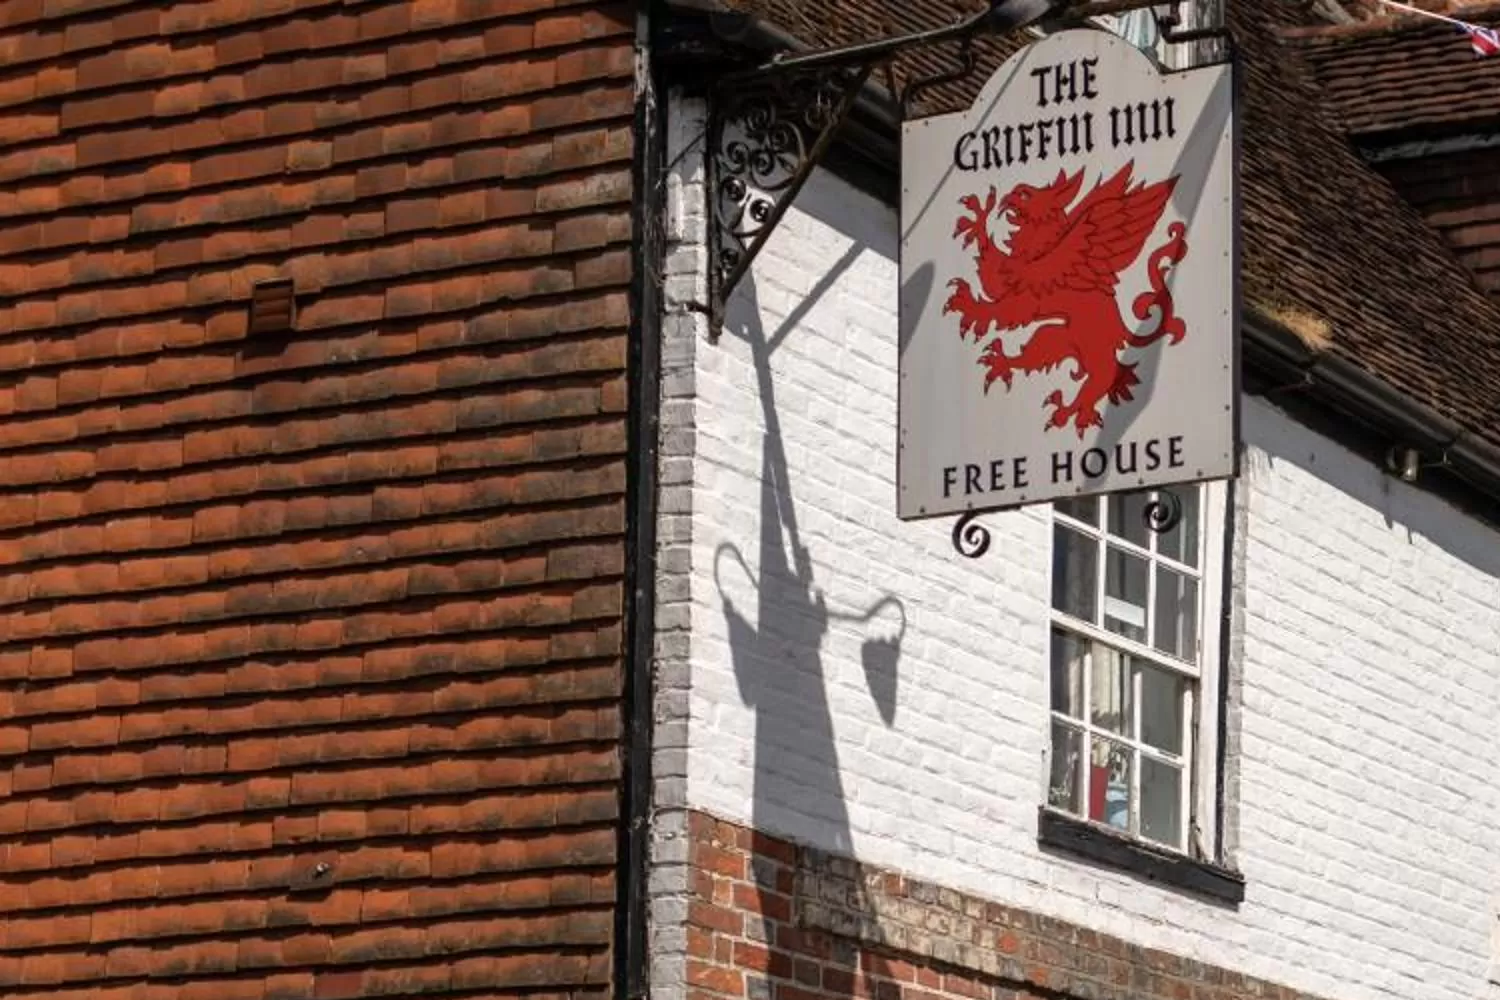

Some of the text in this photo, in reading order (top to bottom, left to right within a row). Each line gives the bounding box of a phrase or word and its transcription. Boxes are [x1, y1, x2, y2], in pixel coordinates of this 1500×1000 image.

[1030, 57, 1099, 108] THE
[953, 96, 1176, 172] GRIFFIN INN
[942, 435, 1186, 498] FREE HOUSE
